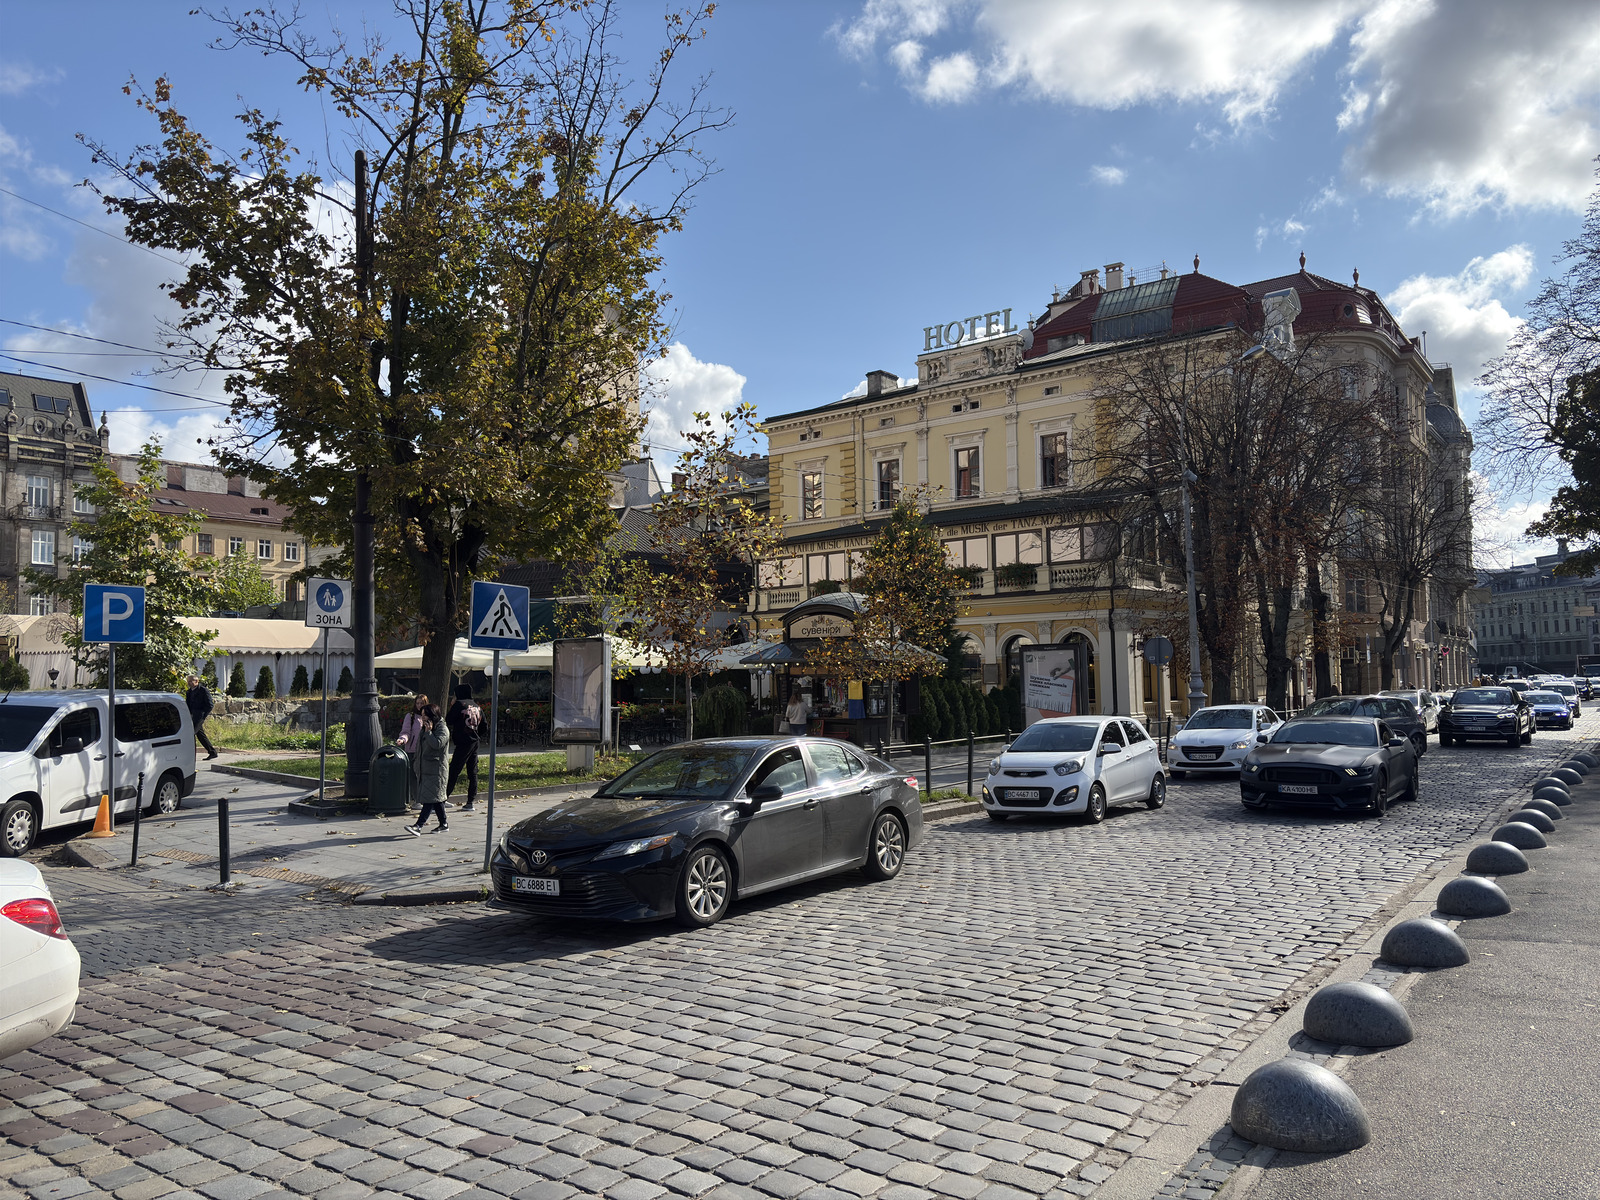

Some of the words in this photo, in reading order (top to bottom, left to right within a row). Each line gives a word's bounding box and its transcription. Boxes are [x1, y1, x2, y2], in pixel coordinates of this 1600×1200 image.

[923, 308, 1018, 351] HOTEL
[960, 523, 990, 535] MUSIK
[993, 522, 1008, 532] der
[817, 540, 841, 551] MUSIC
[102, 592, 134, 636] P
[316, 614, 342, 625] ЗОНА
